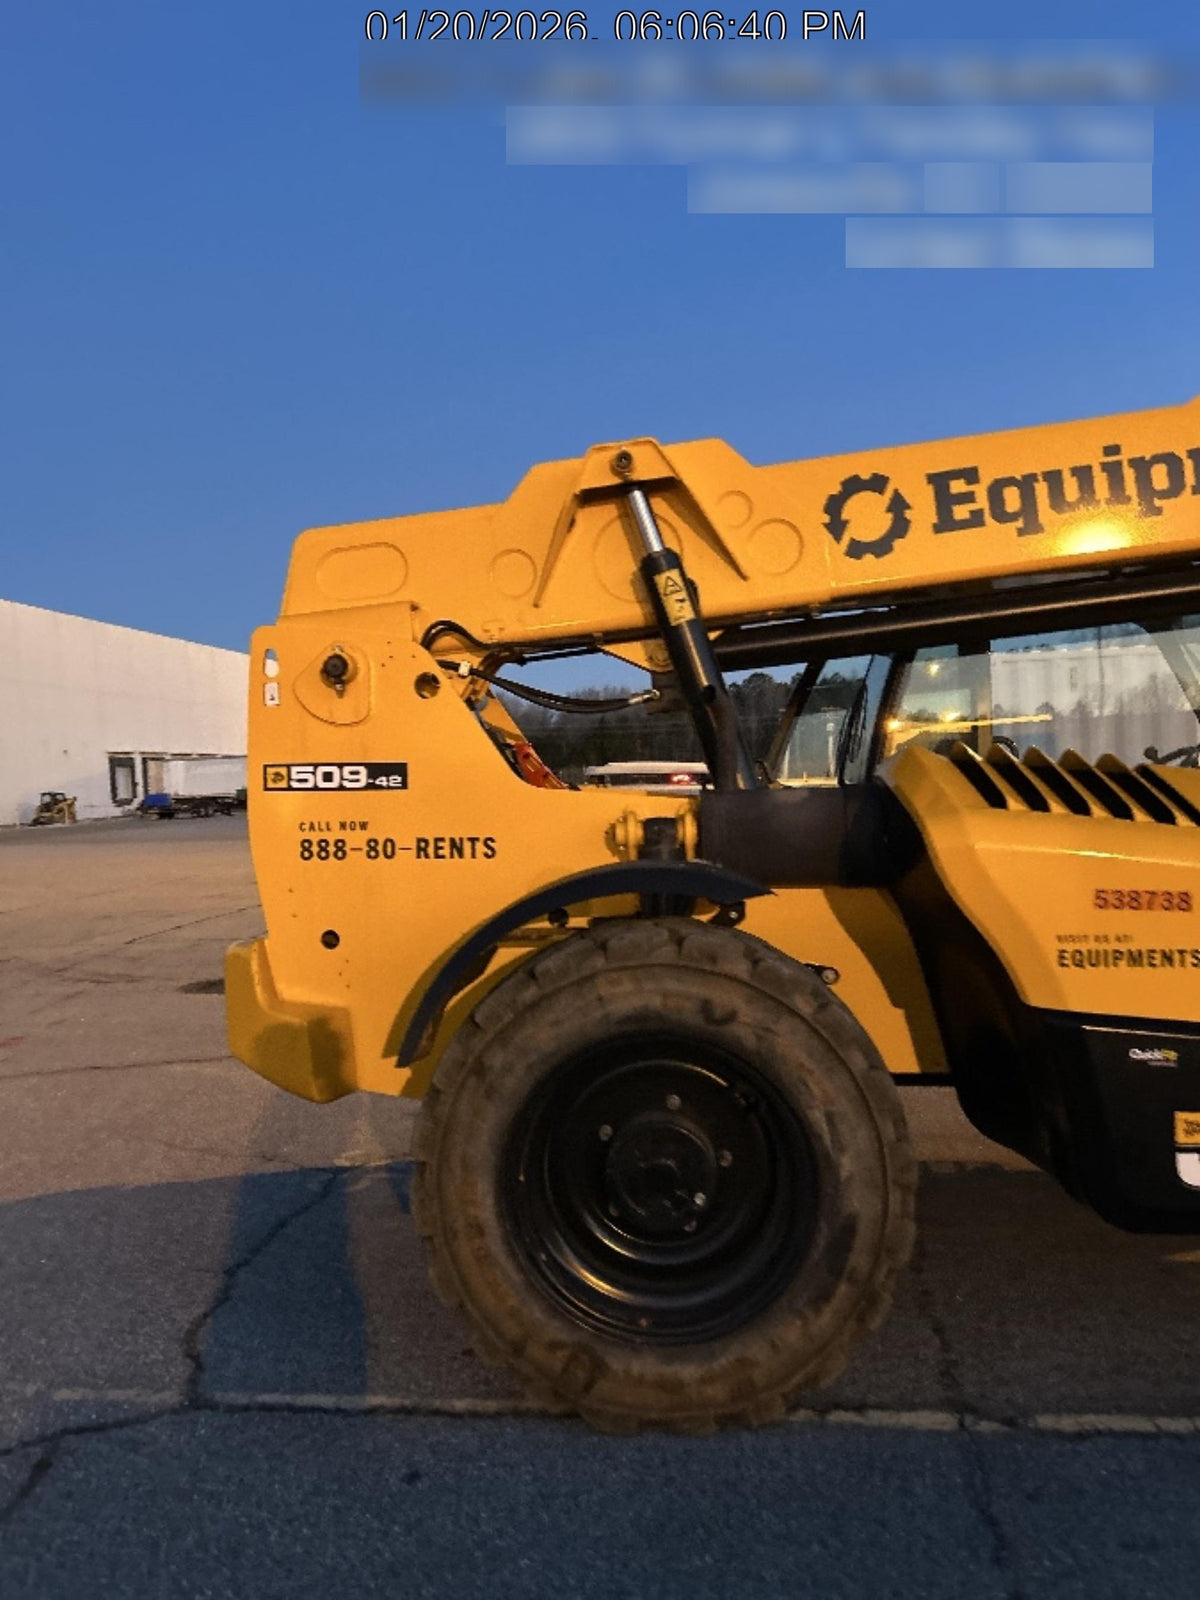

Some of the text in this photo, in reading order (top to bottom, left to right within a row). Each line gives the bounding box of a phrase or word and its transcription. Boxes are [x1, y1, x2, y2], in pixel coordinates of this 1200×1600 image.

[926, 444, 1200, 538] Equip
[289, 765, 403, 789] 509-42
[299, 821, 369, 832] CALL NOW
[300, 837, 497, 861] 888-80-RENTS
[1094, 889, 1193, 912] 538738
